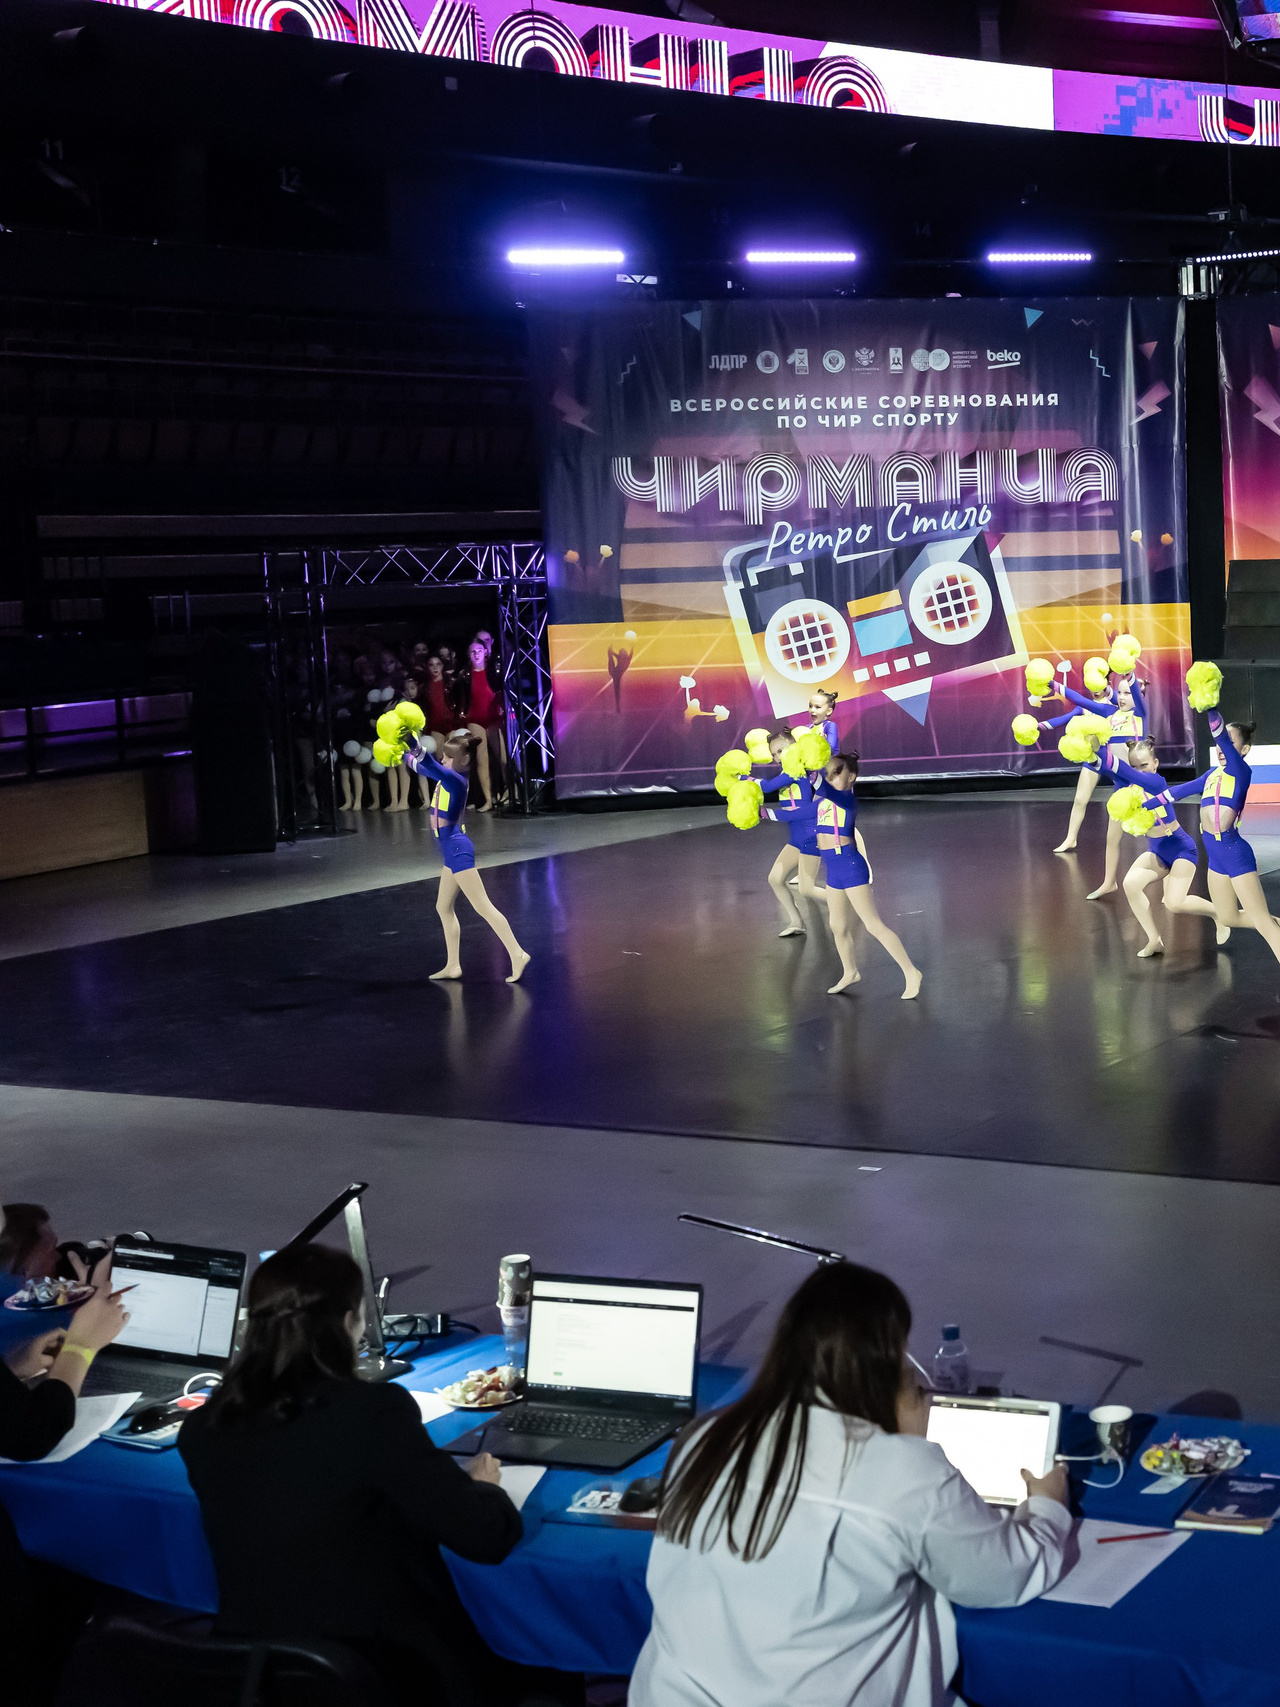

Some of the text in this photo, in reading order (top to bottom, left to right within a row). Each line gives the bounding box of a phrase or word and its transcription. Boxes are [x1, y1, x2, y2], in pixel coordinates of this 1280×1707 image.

[40, 138, 64, 160] 11
[278, 165, 302, 187] 12
[709, 354, 748, 371] ЛДПР
[987, 349, 1021, 362] beko
[670, 393, 1060, 413] ВСЕРОССИЙСКИЕ СОРЕВНОВАНИЯ
[777, 412, 960, 429] ПО ЧИР СПОРТУ
[765, 502, 993, 563] Ретро Стиль
